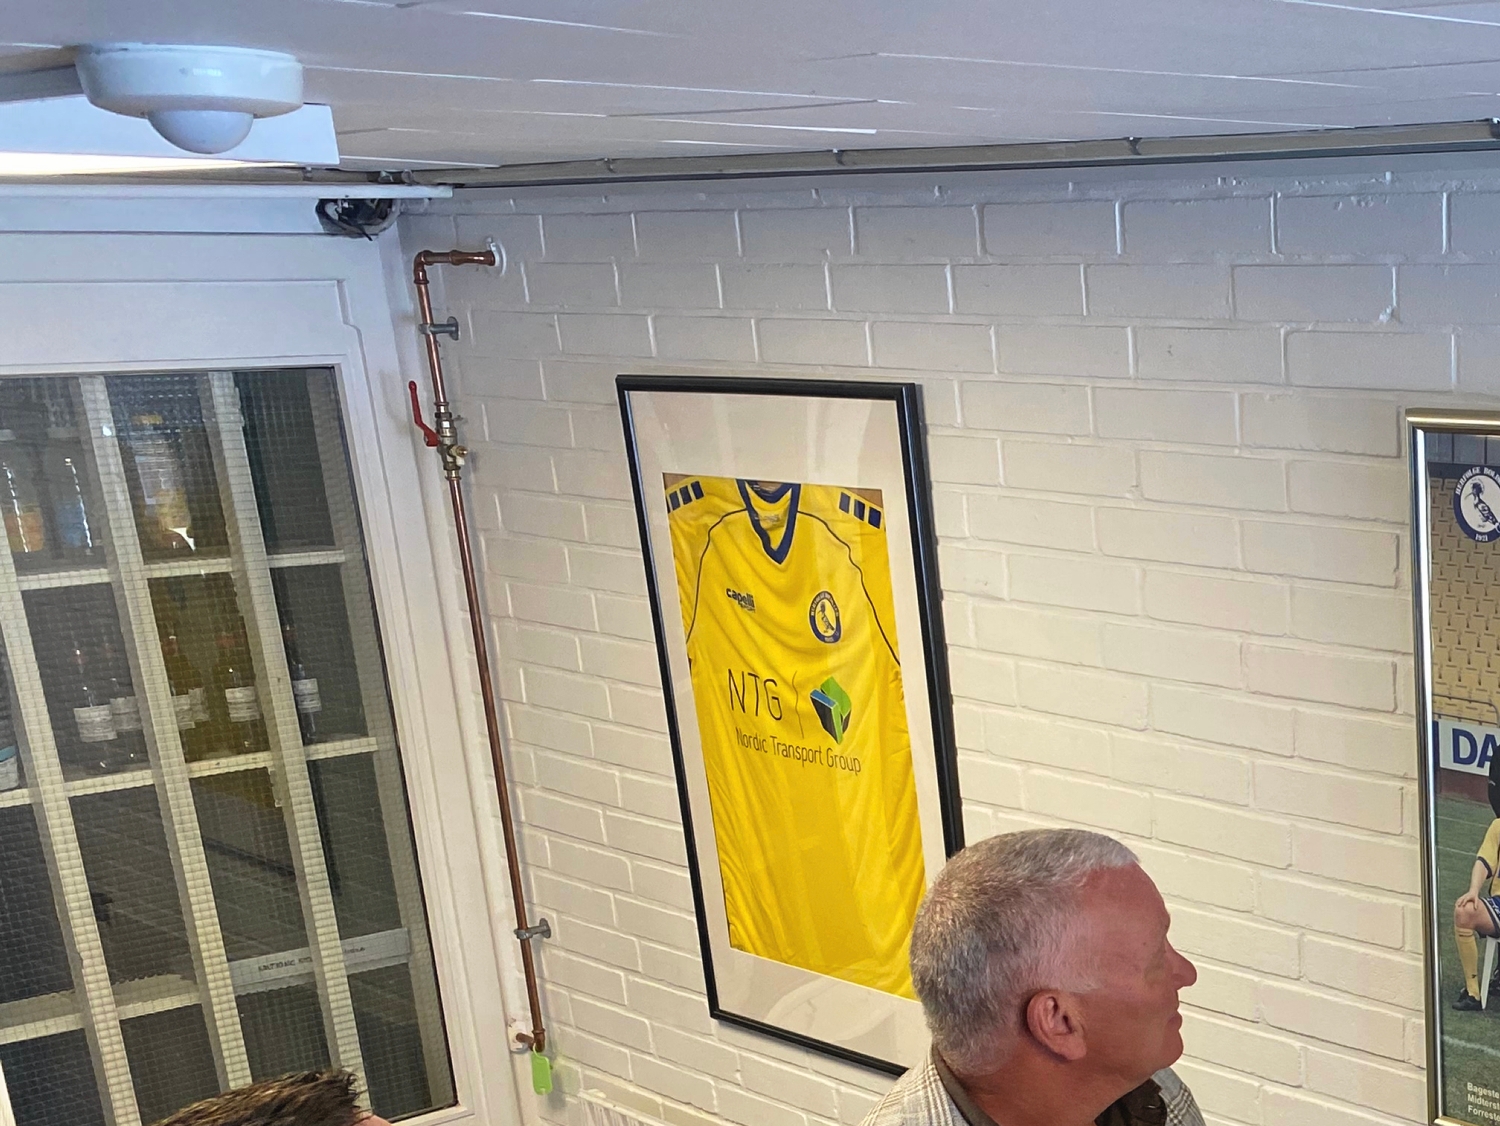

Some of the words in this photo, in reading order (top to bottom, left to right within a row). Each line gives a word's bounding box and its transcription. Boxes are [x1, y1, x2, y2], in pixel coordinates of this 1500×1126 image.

[728, 668, 783, 721] NTG
[735, 726, 768, 754] Nordic
[769, 735, 824, 768] Transport
[826, 747, 862, 776] Group
[1467, 1082, 1500, 1099] Bageste
[1467, 1105, 1500, 1122] Forreste
